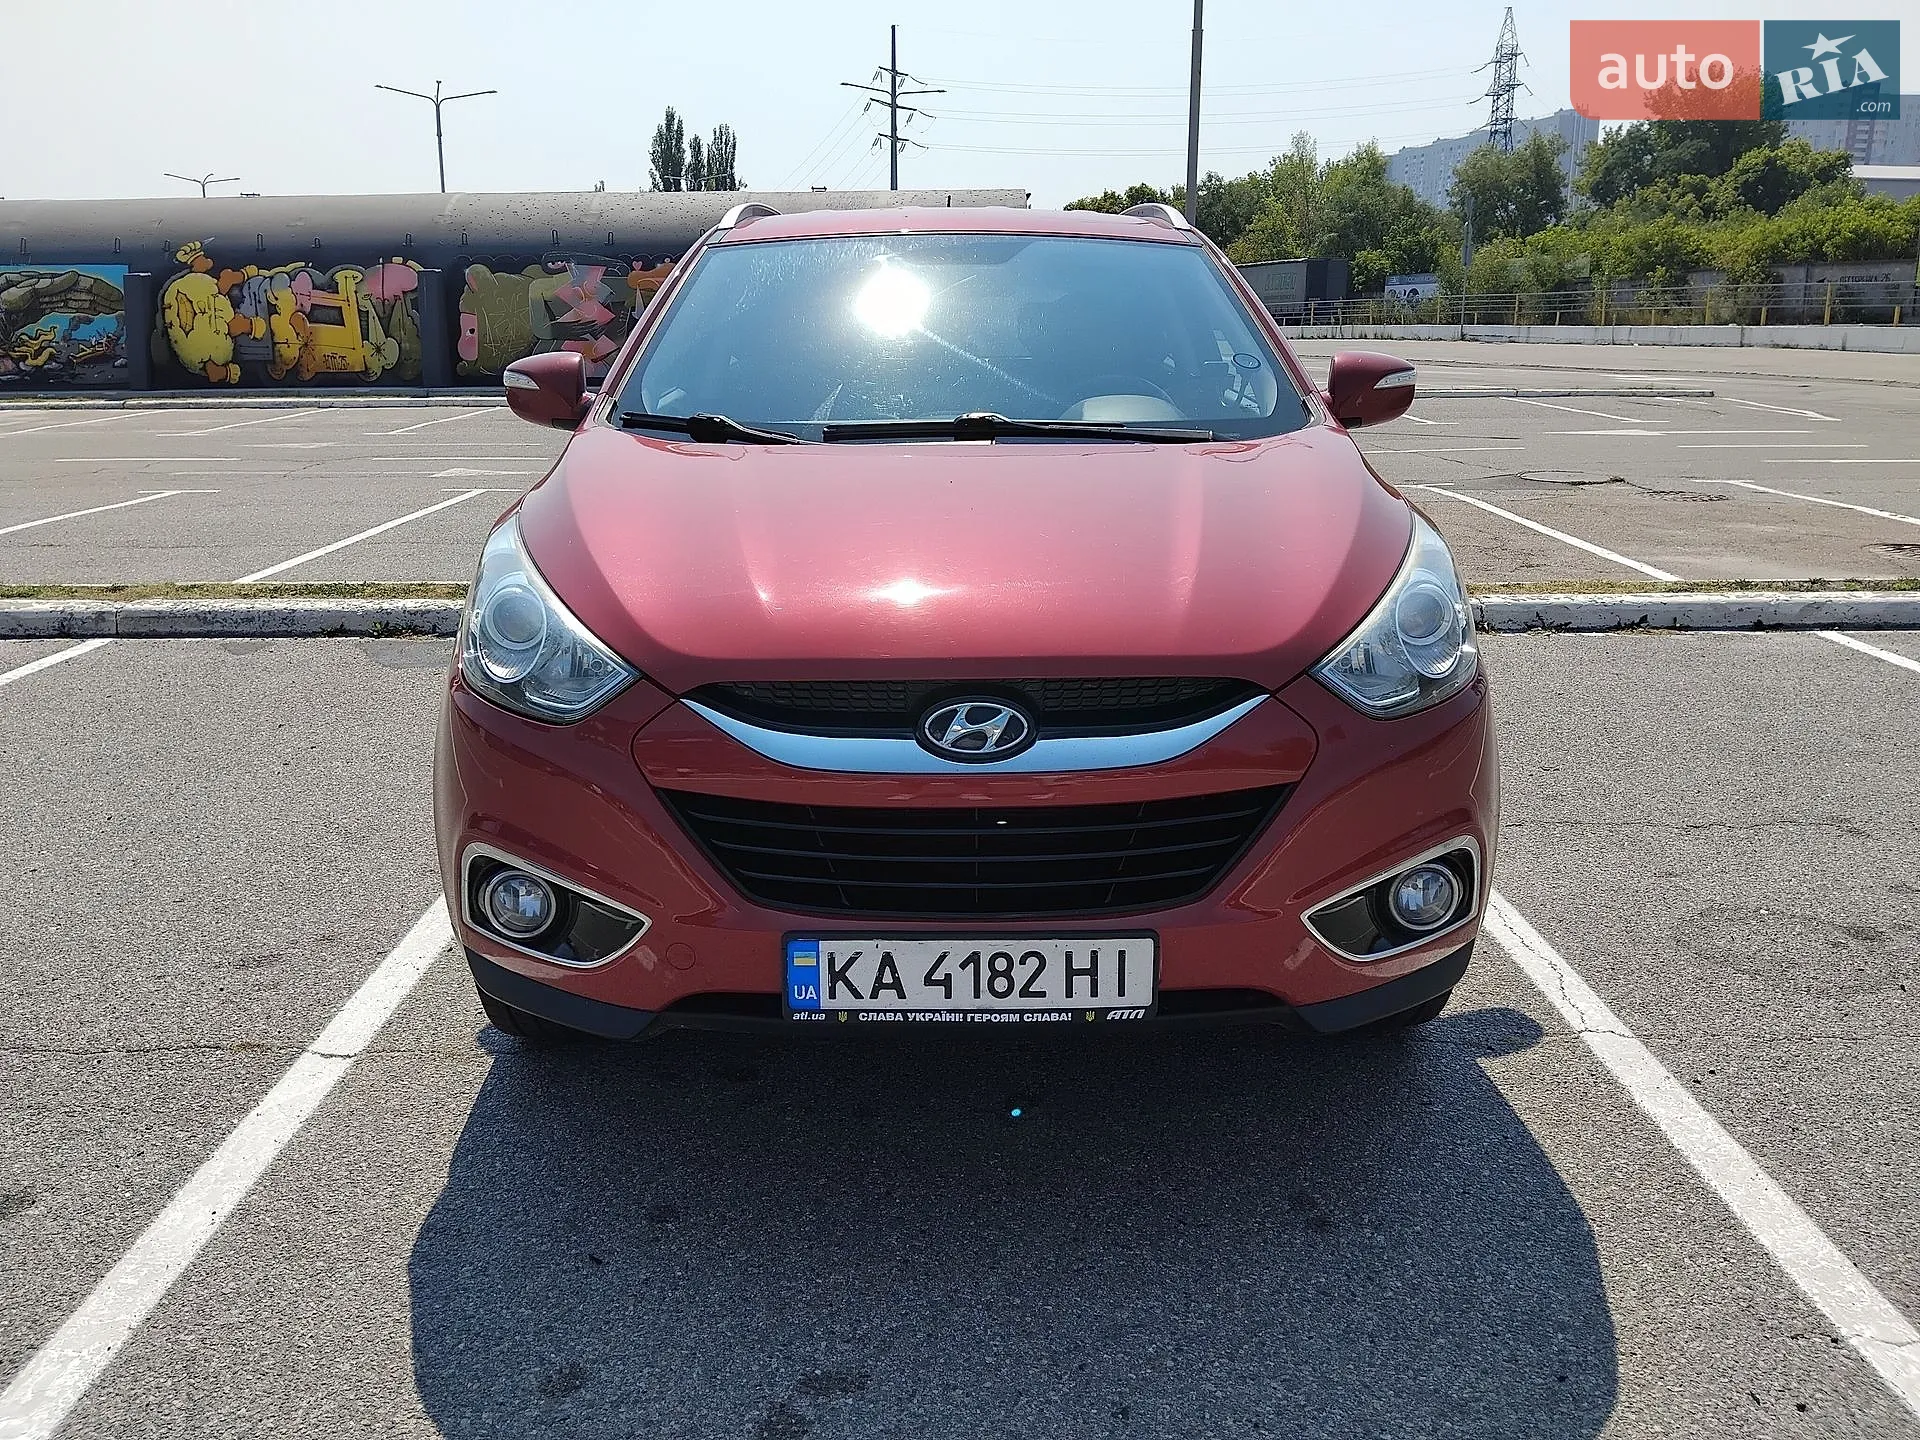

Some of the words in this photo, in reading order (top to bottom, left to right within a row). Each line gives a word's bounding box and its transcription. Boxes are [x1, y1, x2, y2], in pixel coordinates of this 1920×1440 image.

[827, 951, 907, 1000] KA
[923, 950, 1047, 1000] 4182
[1065, 949, 1127, 999] HI
[794, 985, 817, 1000] UA
[792, 1011, 826, 1021] atl.ua
[858, 1012, 904, 1022] СЛАВА
[908, 1010, 963, 1022] УКРАЇНІ!
[967, 1012, 1020, 1023] ГЕРОЯМ
[1024, 1012, 1072, 1022] СЛАВА!
